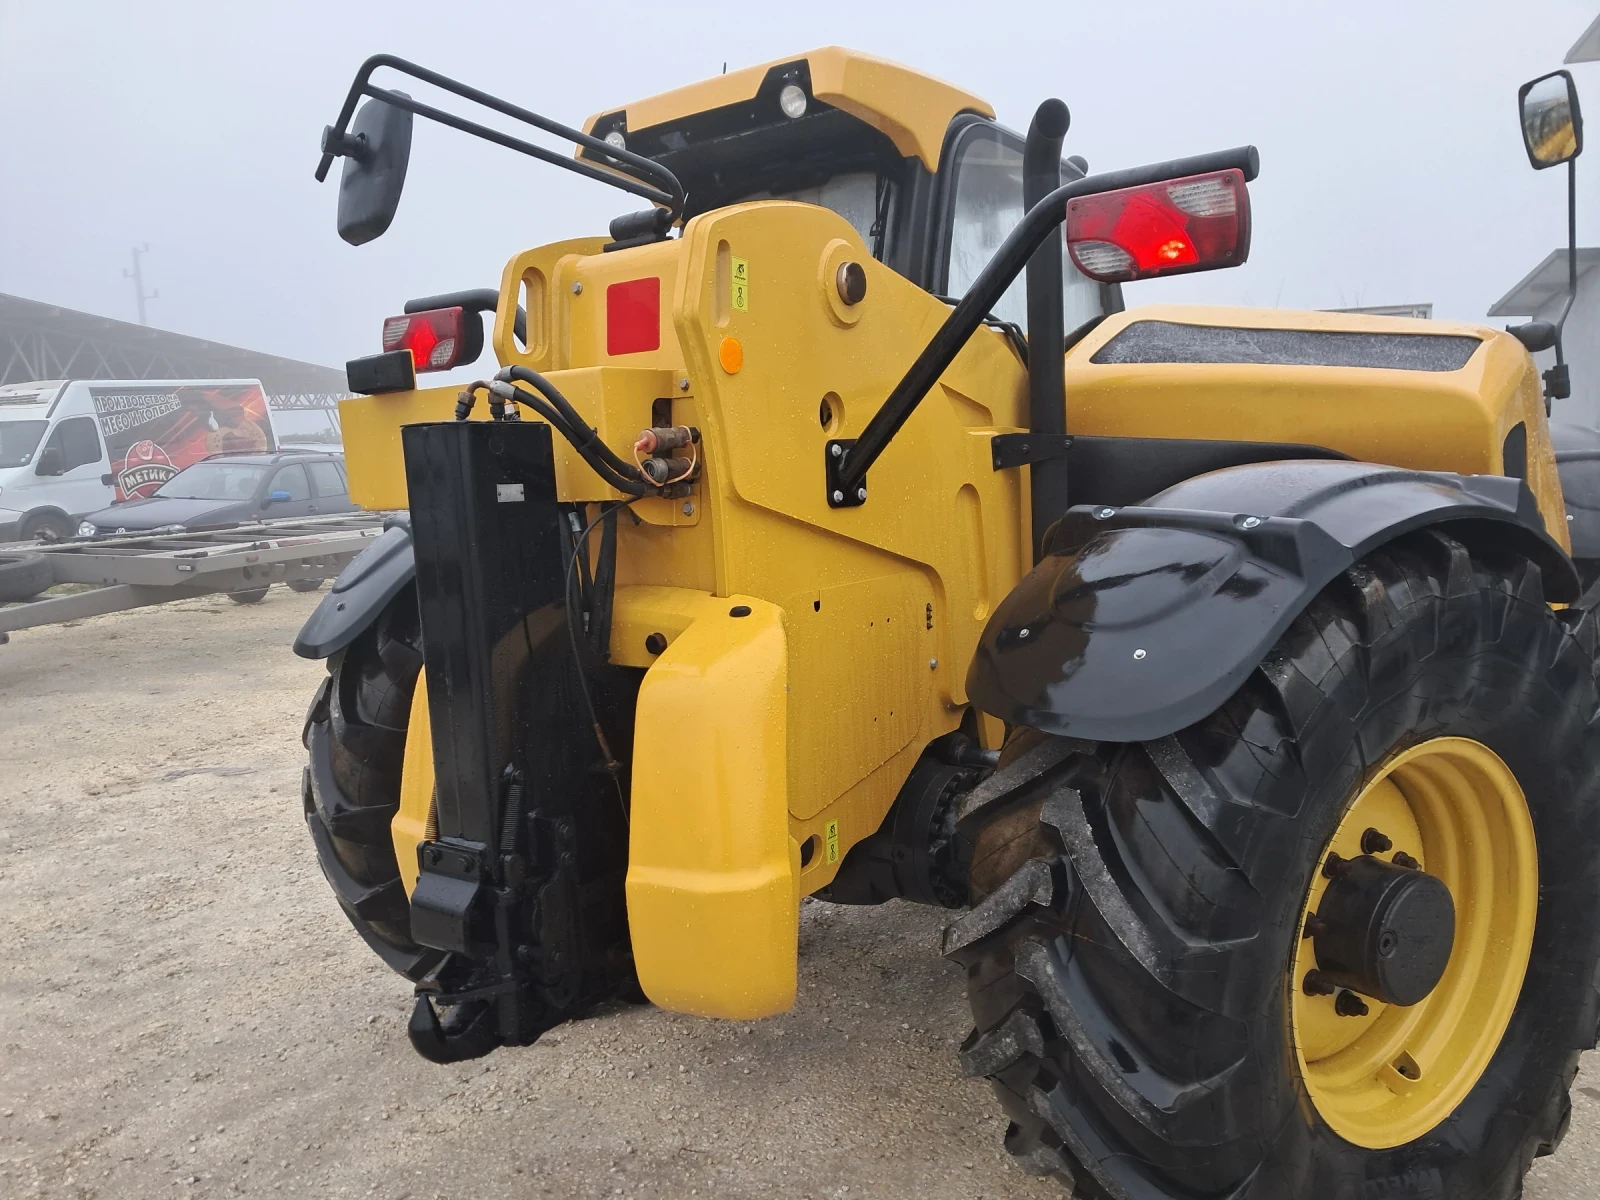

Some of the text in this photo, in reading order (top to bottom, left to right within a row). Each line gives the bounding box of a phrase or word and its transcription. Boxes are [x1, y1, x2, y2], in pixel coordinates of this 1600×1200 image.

[93, 393, 180, 413] ПРОИЗВОДСТВО НА
[100, 401, 182, 437] МЕСО И КОЛБАСИ
